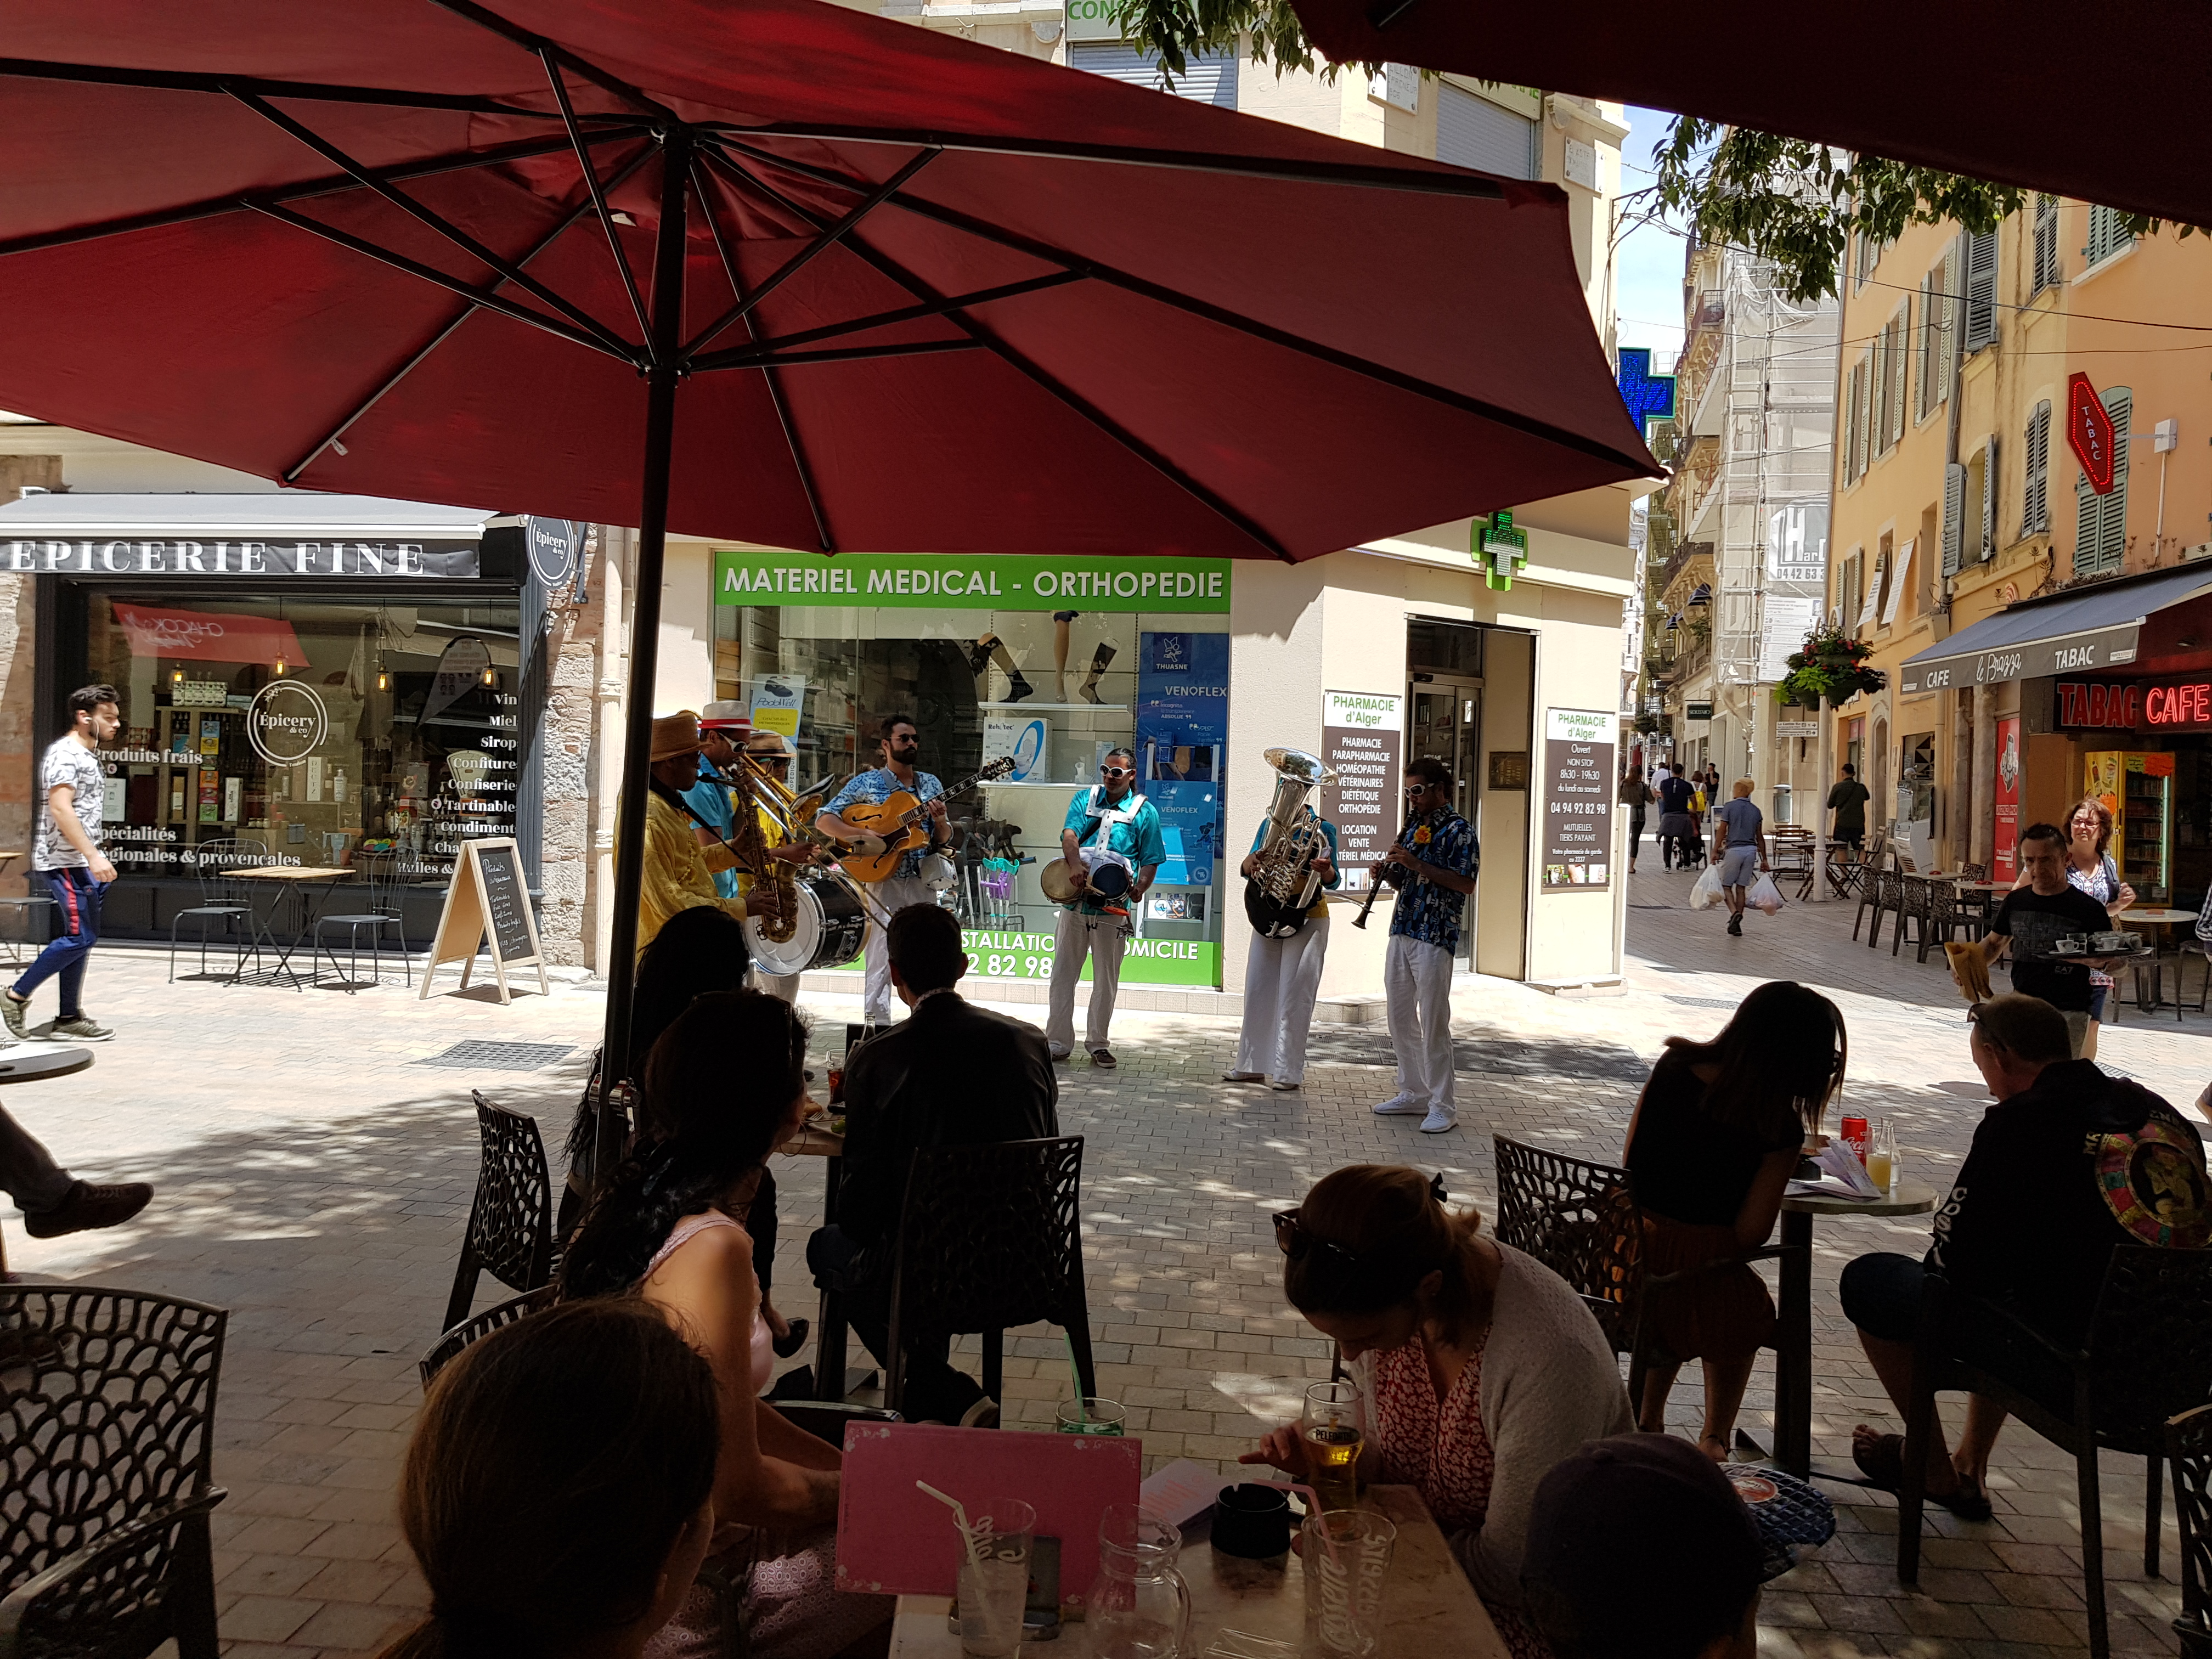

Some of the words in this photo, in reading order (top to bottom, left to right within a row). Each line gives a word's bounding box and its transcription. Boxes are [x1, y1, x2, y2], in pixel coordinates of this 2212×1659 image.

[2081, 406, 2102, 460] TABAC
[536, 528, 568, 560] Épicery
[8, 540, 267, 572] EPICERIE
[294, 542, 424, 575] FINE
[1777, 568, 1788, 579] 04
[1791, 568, 1802, 579] 42
[1805, 568, 1817, 579] 63
[724, 568, 859, 594] MATERIEL
[866, 569, 1002, 595] MEDICAL
[1033, 571, 1223, 598] ORTHOPEDIE
[2055, 645, 2095, 670] TABAC
[1156, 663, 1188, 671] THUASNE
[1985, 653, 2022, 683] Brazza
[1926, 669, 1950, 689] CAFE
[1165, 686, 1227, 697] VENOFLEX
[1333, 695, 1395, 712] PHARMACIE
[2057, 682, 2138, 729] TABAC
[2146, 684, 2210, 725] CAFE
[259, 711, 317, 738] Épicery
[489, 715, 518, 727] Miel
[1346, 710, 1382, 727] d'Alger
[1558, 714, 1606, 727] PHARMACIE
[1568, 727, 1596, 740] d'Alger
[1341, 737, 1382, 749] PHARMACIE
[1571, 743, 1591, 754] Ouvert
[162, 748, 204, 765] frais
[1332, 749, 1390, 763] PARAPHARMACIE
[1336, 761, 1386, 775] HOMÉOPATHIE
[1567, 758, 1580, 767] NON
[1581, 759, 1594, 768] STOP
[1338, 775, 1384, 788] VÉTÉRINAIRES
[1560, 769, 1576, 780] 8h30
[1581, 770, 1600, 781] 19h30
[1341, 788, 1379, 802] DIÉTÉTIQUE
[1557, 783, 1564, 792] du
[1565, 783, 1577, 793] lundi
[1584, 784, 1601, 794] samedi
[1161, 806, 1199, 814] VENOFLEX
[1338, 802, 1381, 814] ORTHOPÉDIE
[1550, 802, 1561, 814] 04
[1562, 802, 1572, 814] 94
[1574, 803, 1583, 814] 92
[1585, 803, 1595, 815] 82
[1596, 803, 1606, 815] 98
[100, 825, 177, 847] pécialités
[1341, 825, 1377, 834] LOCATION
[1348, 838, 1369, 848] VENTE
[1560, 833, 1573, 842] TIERS
[1574, 834, 1596, 842] PAYANT
[435, 841, 460, 853] Cha
[102, 845, 177, 865] égionales
[179, 850, 196, 863] &
[198, 851, 302, 868] provençales
[1336, 849, 1359, 861] TÉRIEL
[441, 862, 454, 876] &
[962, 930, 1055, 952] STALLATIO
[966, 953, 980, 974] 2
[987, 955, 1017, 977] 82
[1024, 956, 1053, 978] 98
[2054, 966, 2074, 975] EA7
